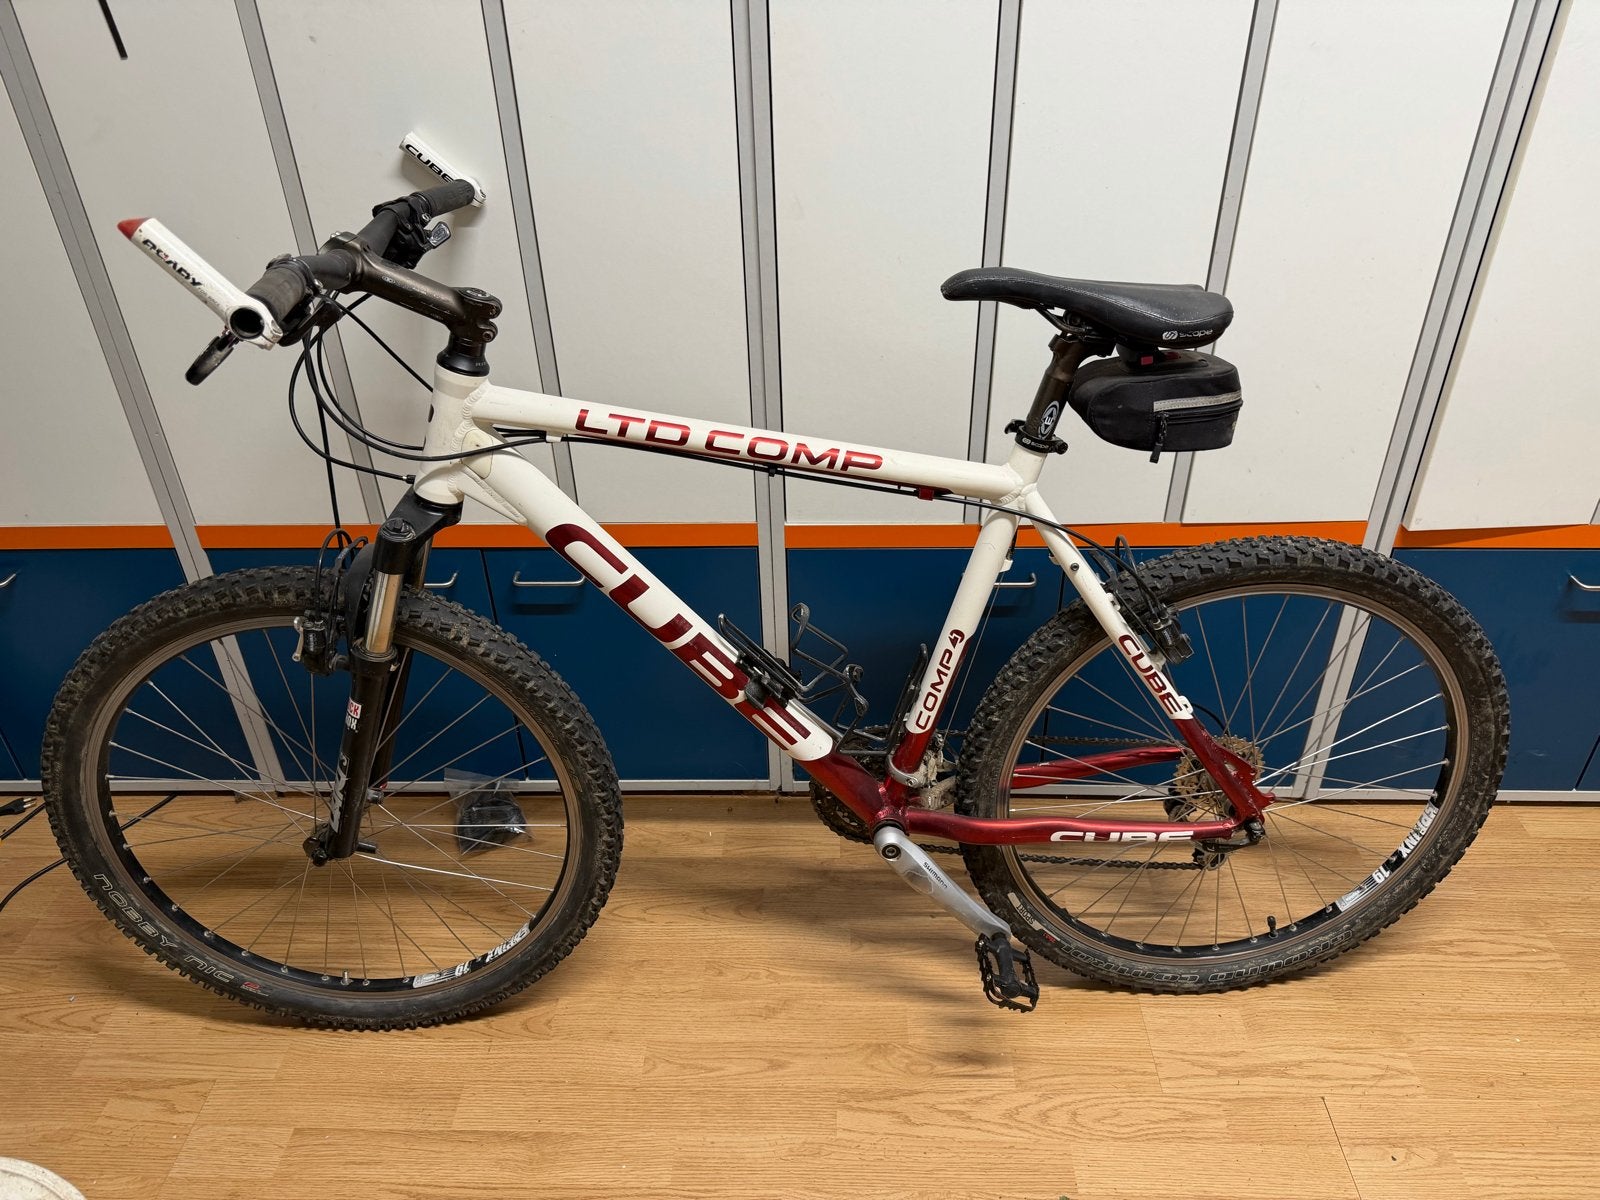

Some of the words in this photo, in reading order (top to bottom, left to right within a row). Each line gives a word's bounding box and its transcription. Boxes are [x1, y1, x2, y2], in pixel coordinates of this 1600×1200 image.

[405, 143, 456, 183] CUBE
[575, 408, 691, 447] LTD
[704, 429, 883, 472] COMP
[545, 523, 811, 751] CUBE
[916, 646, 955, 731] COMP
[1118, 634, 1182, 716] CUBE
[1050, 830, 1194, 843] CUBE
[1373, 866, 1390, 884] 19
[1016, 904, 1035, 925] SPORT
[1060, 943, 1199, 984] CONTROL
[1209, 929, 1354, 983] GROUND
